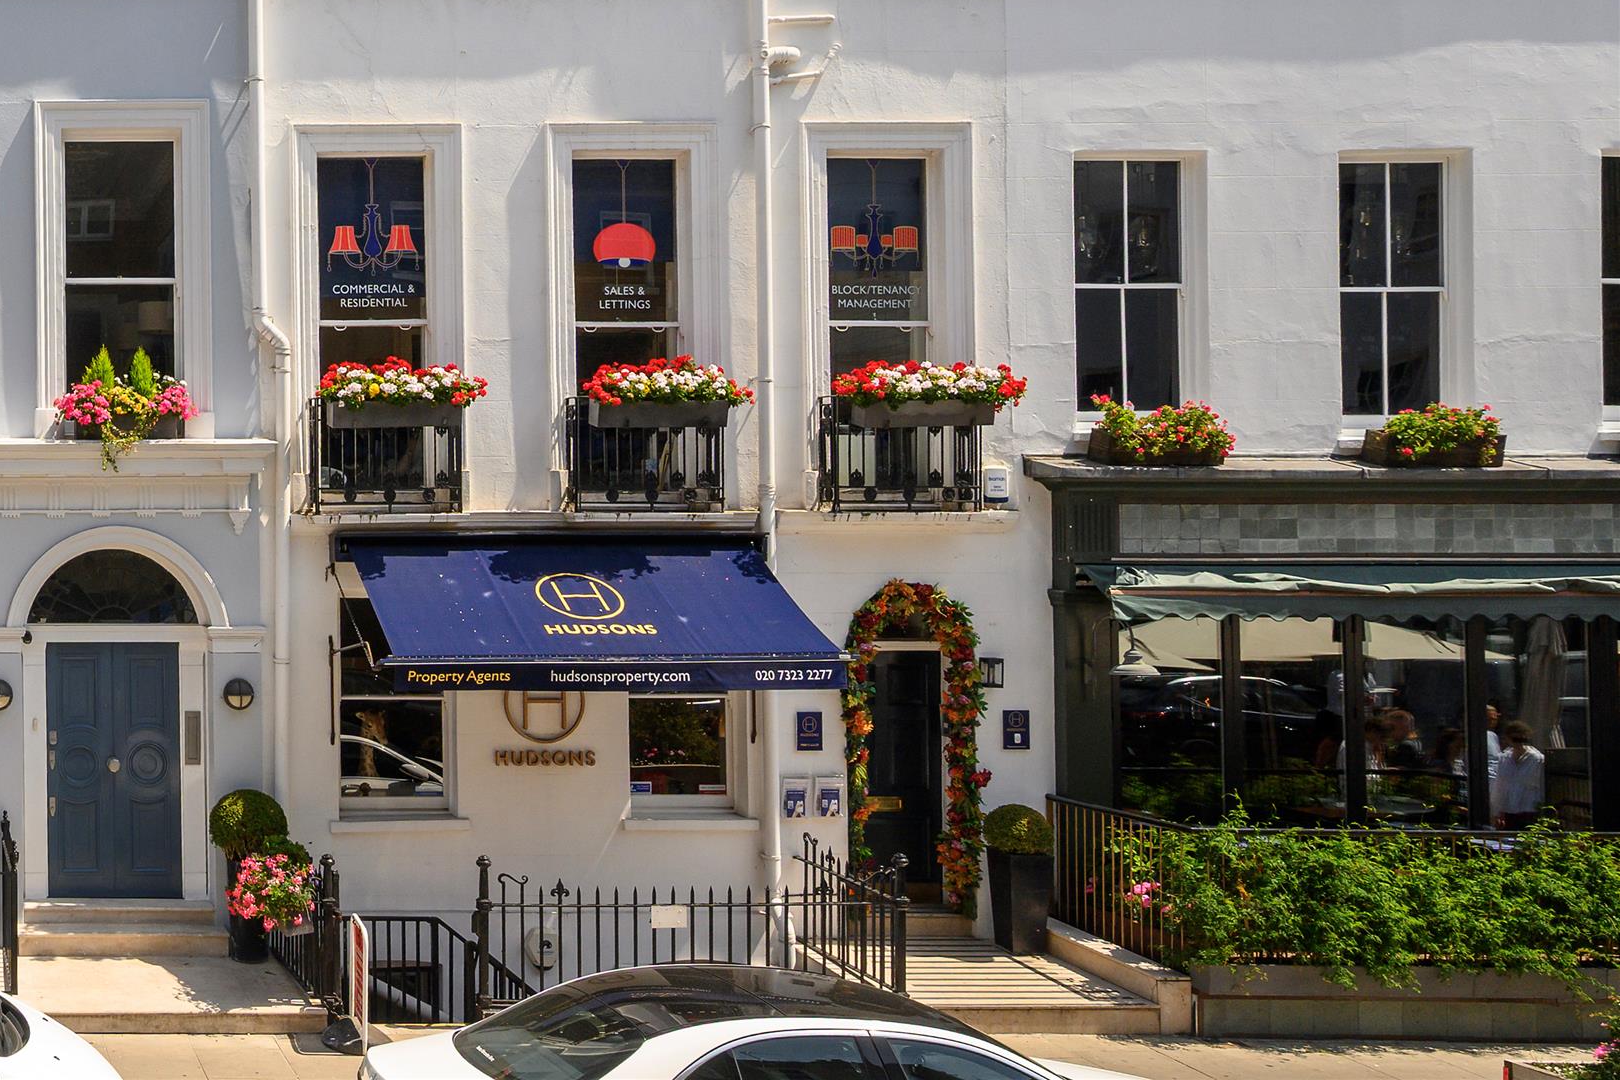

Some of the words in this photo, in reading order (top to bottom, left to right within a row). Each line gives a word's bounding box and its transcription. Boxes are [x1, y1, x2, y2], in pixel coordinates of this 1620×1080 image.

[332, 284, 404, 294] COMMERCIAL
[407, 284, 415, 293] &
[604, 286, 634, 296] SALES
[637, 286, 645, 295] &
[831, 285, 921, 295] BLOCK/TENANCY
[340, 298, 408, 307] RESIDENTIAL
[599, 300, 651, 309] LETTINGS
[838, 299, 912, 308] MANAGEMENT
[543, 624, 658, 635] HUDSONS
[407, 670, 463, 684] Property
[466, 670, 511, 684] Agents
[550, 670, 691, 686] hudsonsproperty.com
[755, 670, 775, 680] 020
[777, 670, 804, 680] 7323
[806, 669, 833, 680] 2277
[494, 750, 596, 766] HUDSONS
